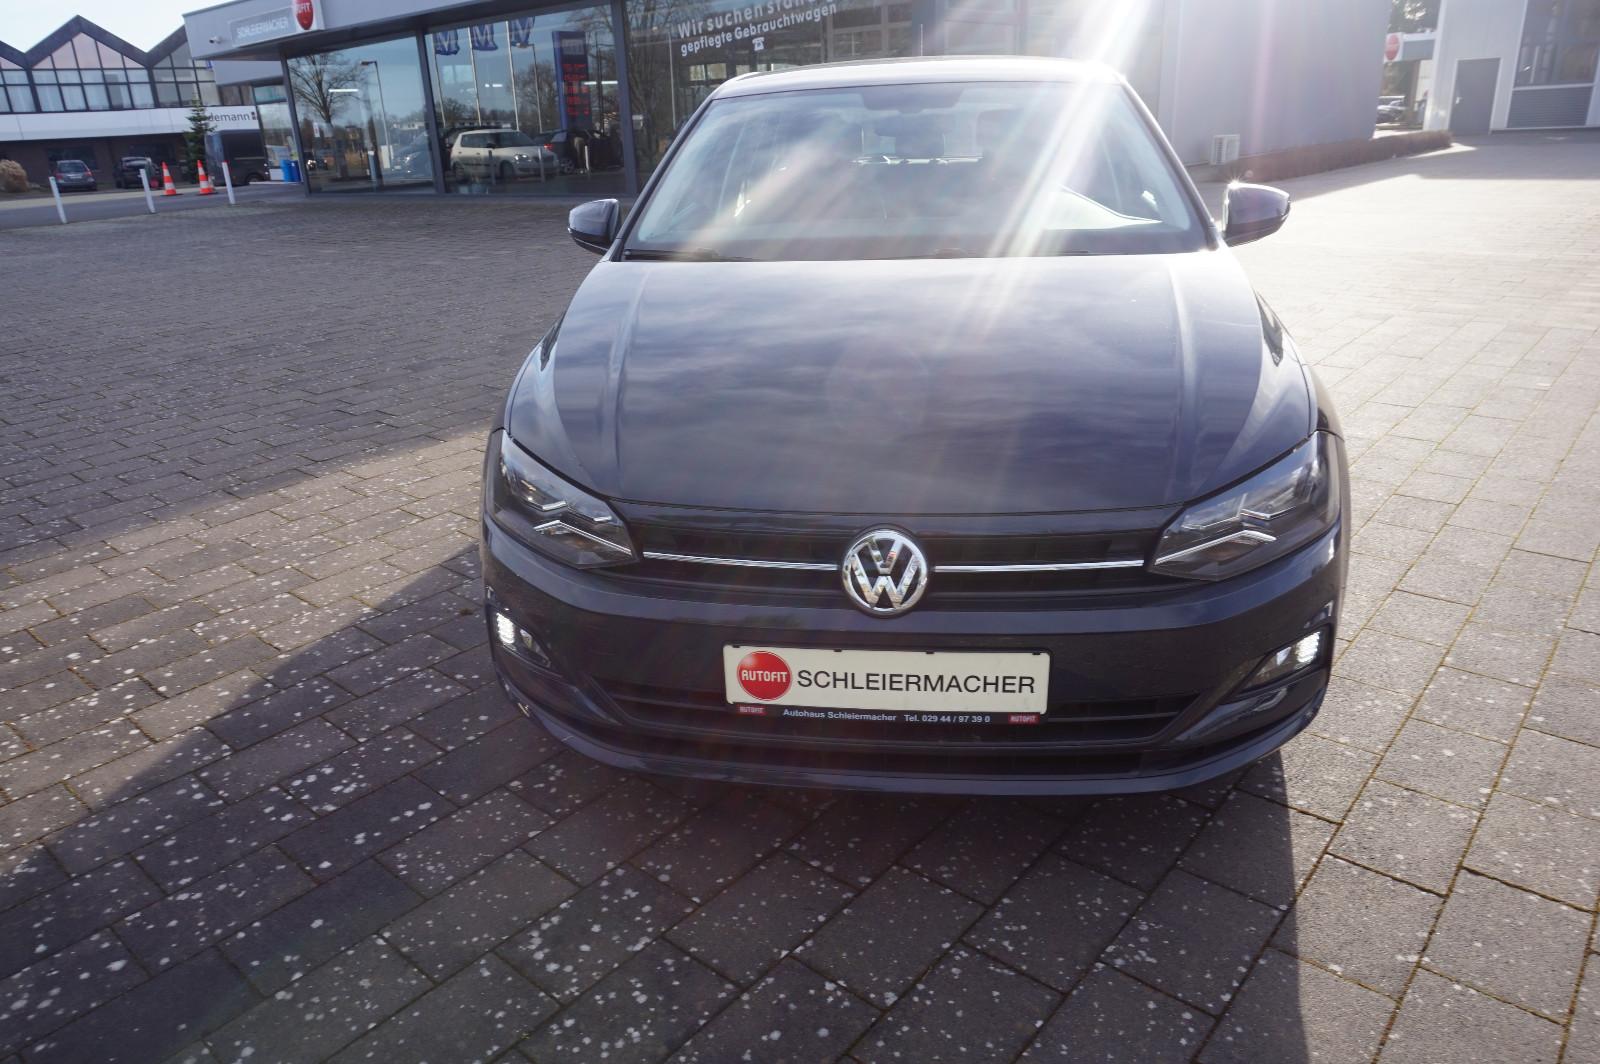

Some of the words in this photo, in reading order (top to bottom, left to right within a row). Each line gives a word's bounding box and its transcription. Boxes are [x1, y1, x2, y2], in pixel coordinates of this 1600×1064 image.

[678, 19, 703, 38] Wir
[707, 5, 763, 31] suchen
[680, 32, 732, 57] gepflegte
[734, 3, 837, 39] Gebrauchtwagen
[208, 112, 250, 121] demann
[741, 669, 788, 683] AUTOFIT
[797, 669, 1035, 694] SCHLEIERMACHER
[783, 708, 825, 718] Autohaus
[827, 711, 897, 721] Schleiermacher
[904, 714, 920, 722] Tel.
[921, 714, 939, 723] 029
[939, 714, 951, 723] 44
[958, 715, 971, 723] 97
[971, 715, 983, 723] 39
[984, 715, 991, 723] 0
